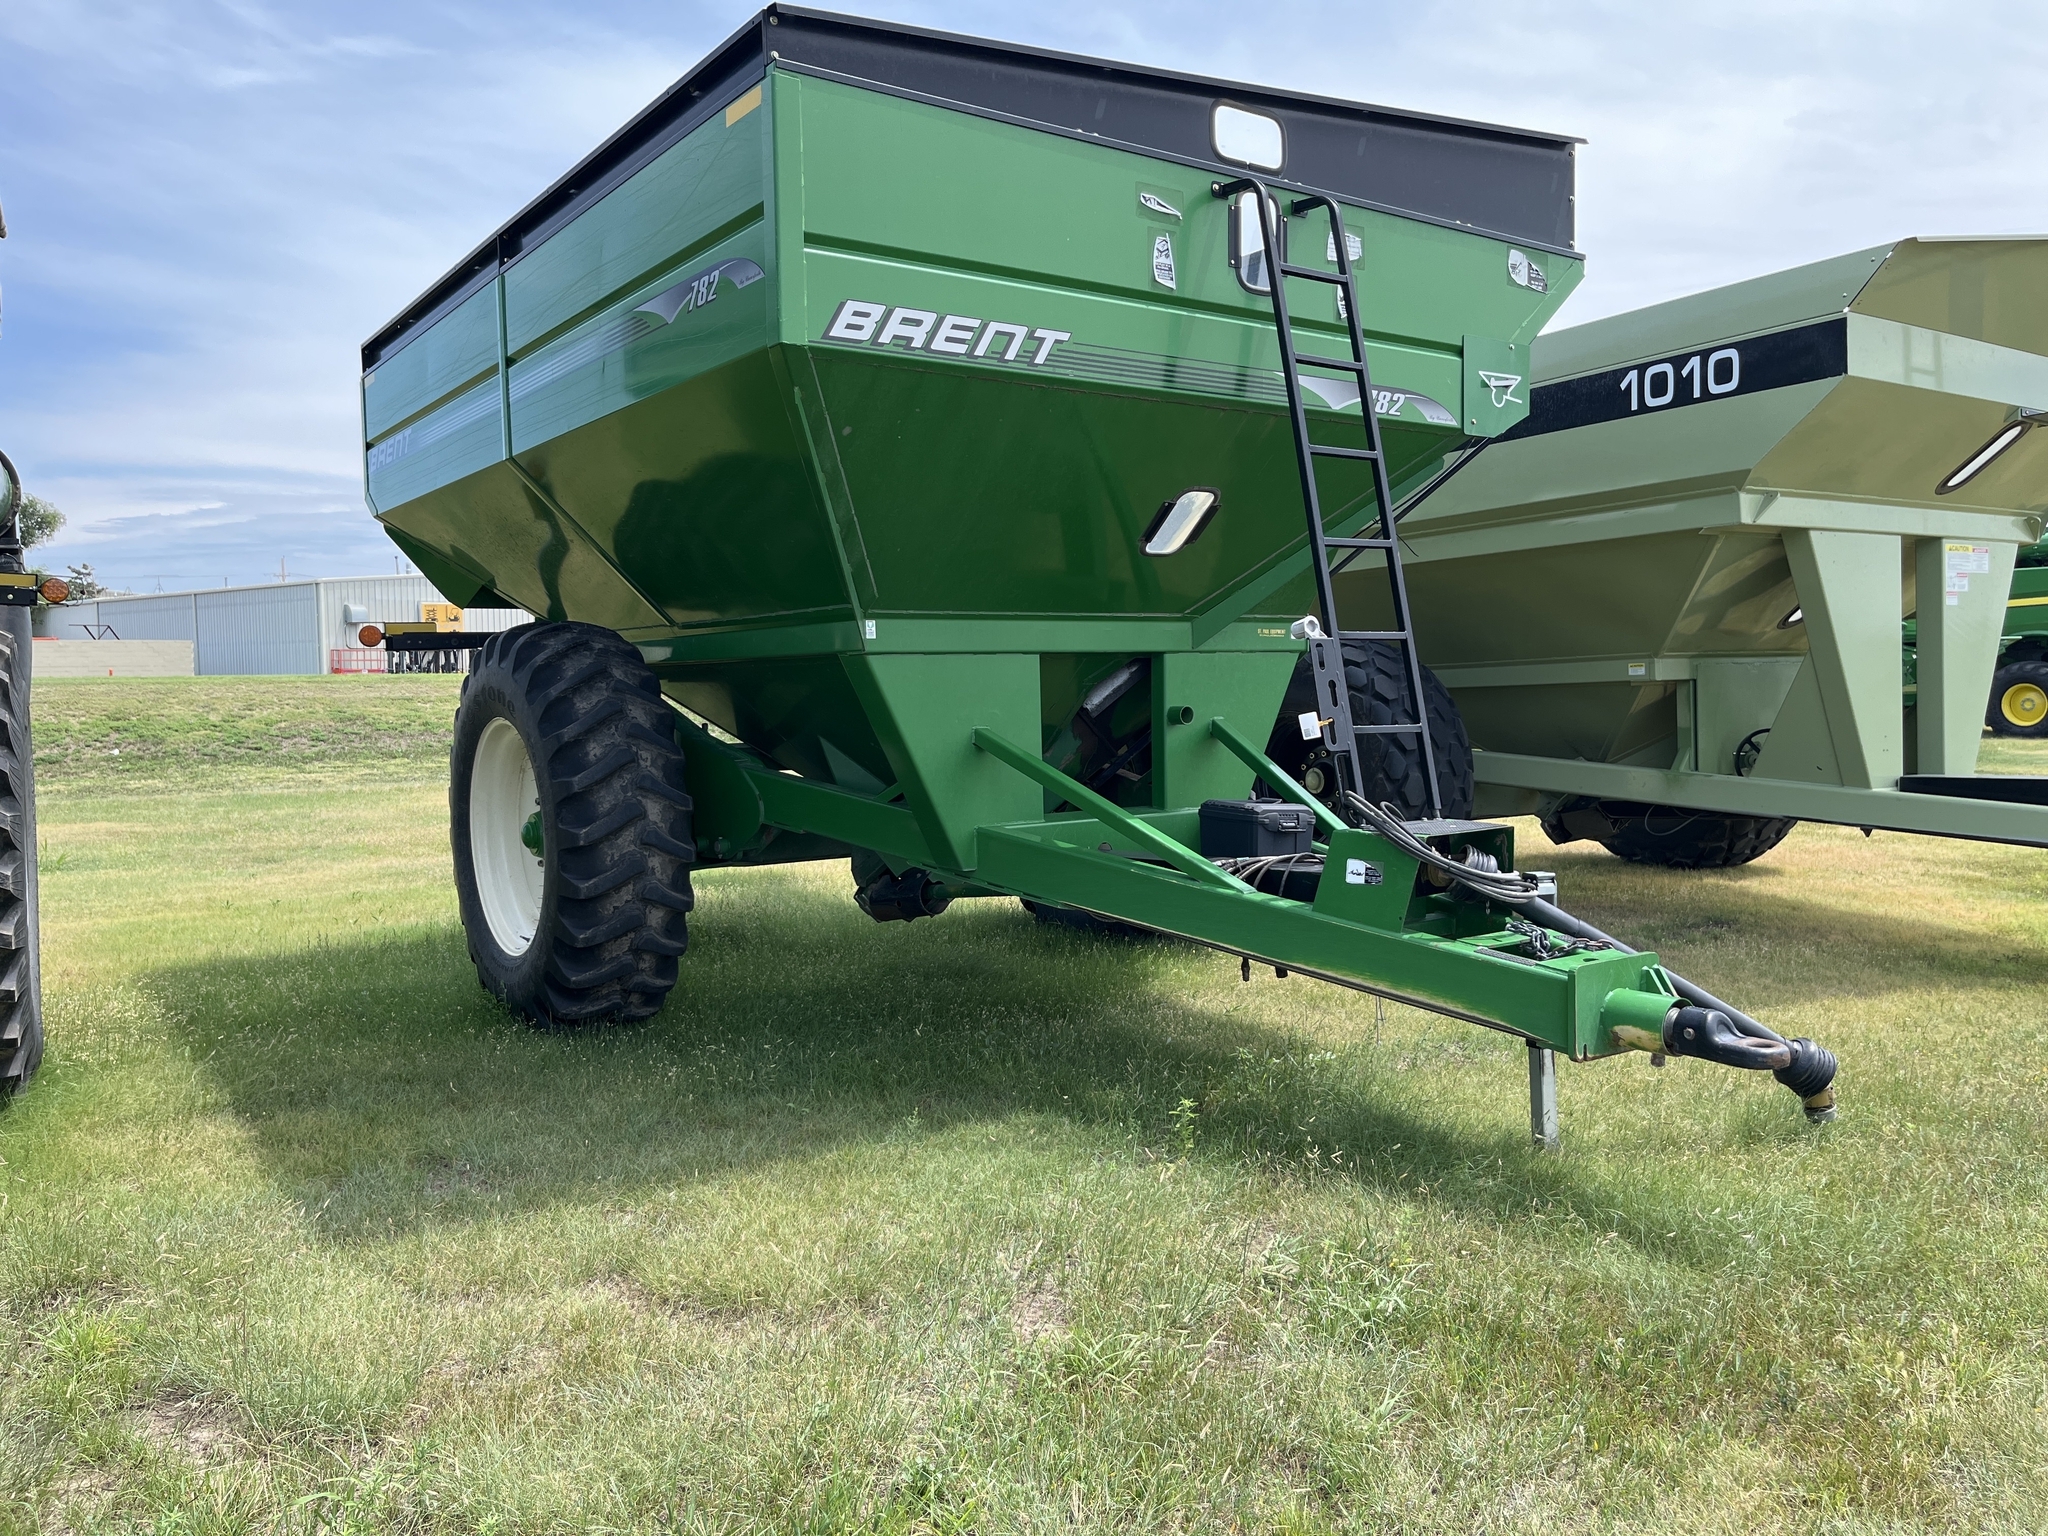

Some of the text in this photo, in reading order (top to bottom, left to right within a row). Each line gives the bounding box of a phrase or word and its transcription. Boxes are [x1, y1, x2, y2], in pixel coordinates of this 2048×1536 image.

[687, 269, 720, 313] 782
[822, 299, 1072, 367] BRENT
[1619, 347, 1740, 411] 1010
[370, 427, 413, 473] BRENT
